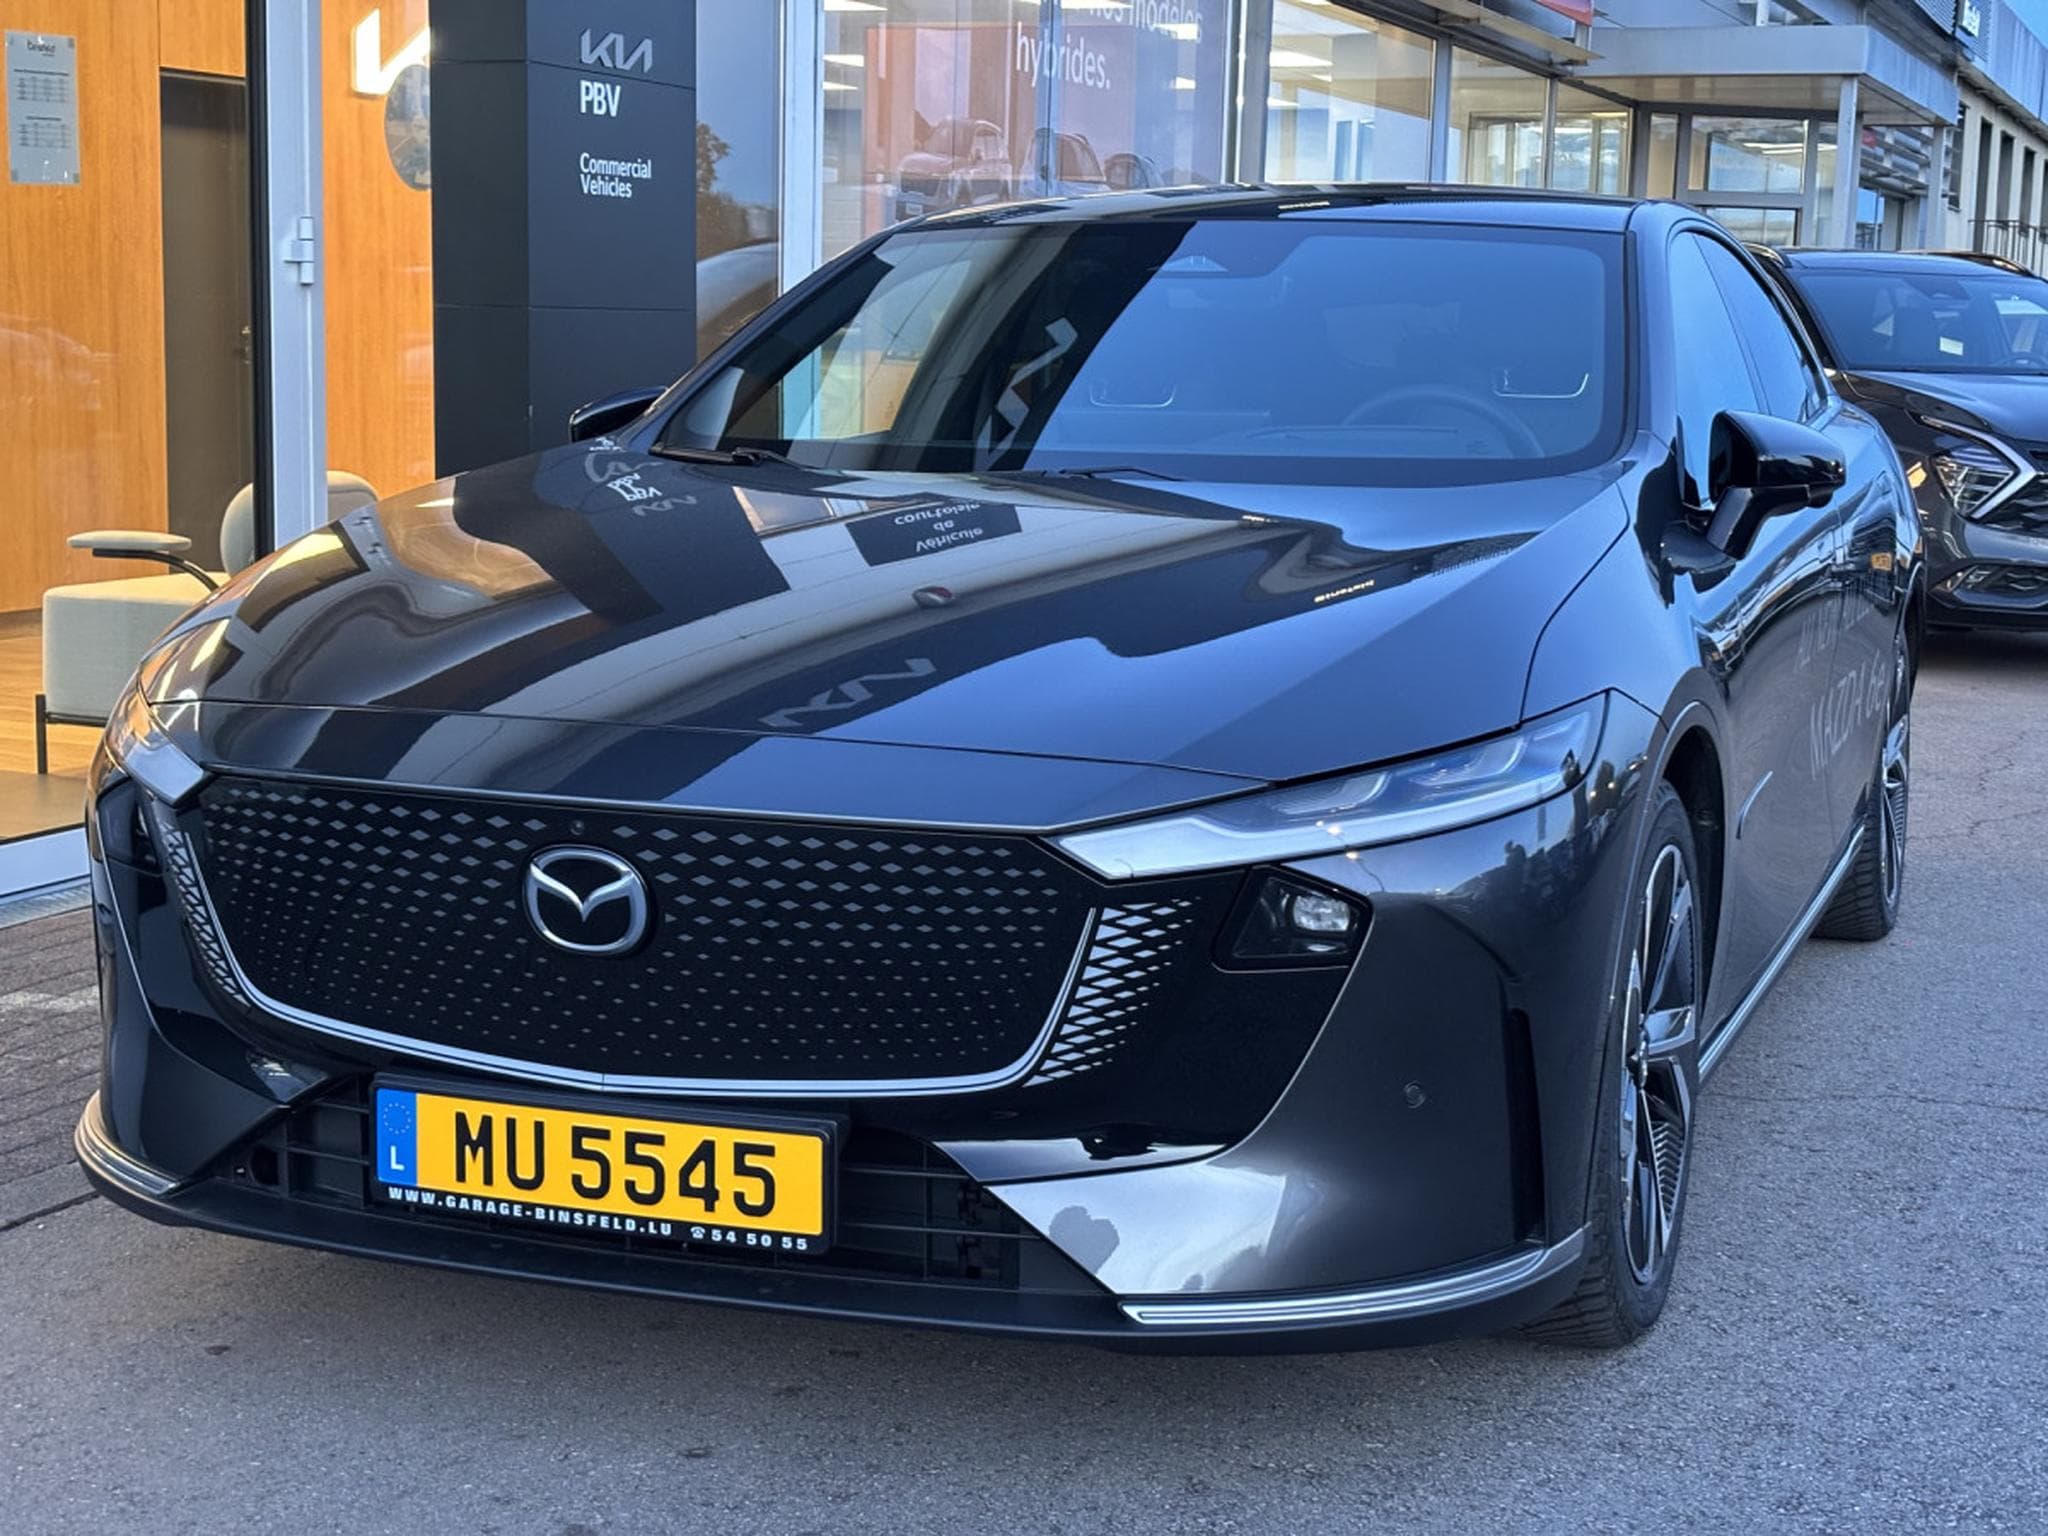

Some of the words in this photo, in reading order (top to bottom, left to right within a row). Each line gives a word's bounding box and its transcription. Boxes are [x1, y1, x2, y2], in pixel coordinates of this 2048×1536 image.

[580, 28, 653, 73] KIA
[1016, 21, 1111, 90] hybrides.
[580, 80, 621, 117] PBV
[580, 152, 652, 179] Commercial
[580, 173, 633, 198] Vehicles
[390, 1145, 405, 1171] L
[455, 1111, 545, 1191] MU
[571, 1125, 776, 1217] 5545
[388, 1186, 672, 1236] WWW.GARAGE-BINSFELD.LU
[711, 1228, 737, 1244] 54
[746, 1232, 772, 1248] 50
[781, 1236, 808, 1251] 55
